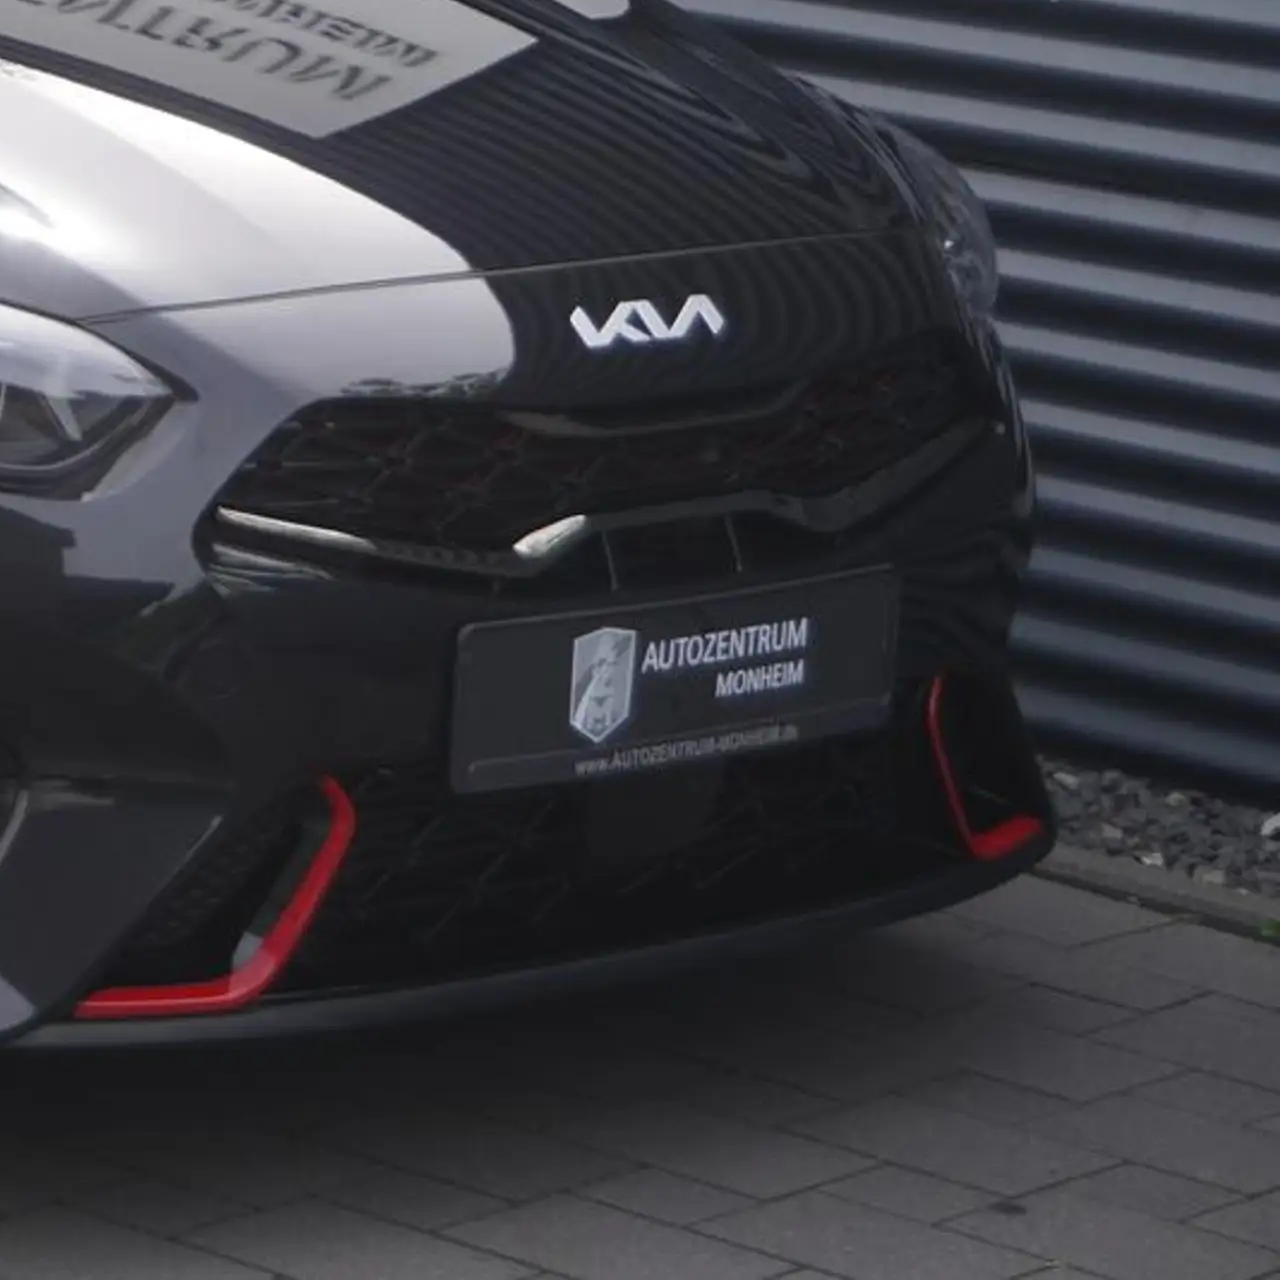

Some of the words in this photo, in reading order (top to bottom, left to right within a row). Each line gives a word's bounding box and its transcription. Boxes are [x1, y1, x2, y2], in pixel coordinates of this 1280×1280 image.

[569, 293, 724, 349] KIA
[641, 618, 808, 674] AUTOZENTRUM
[714, 660, 805, 697] MONHEIM
